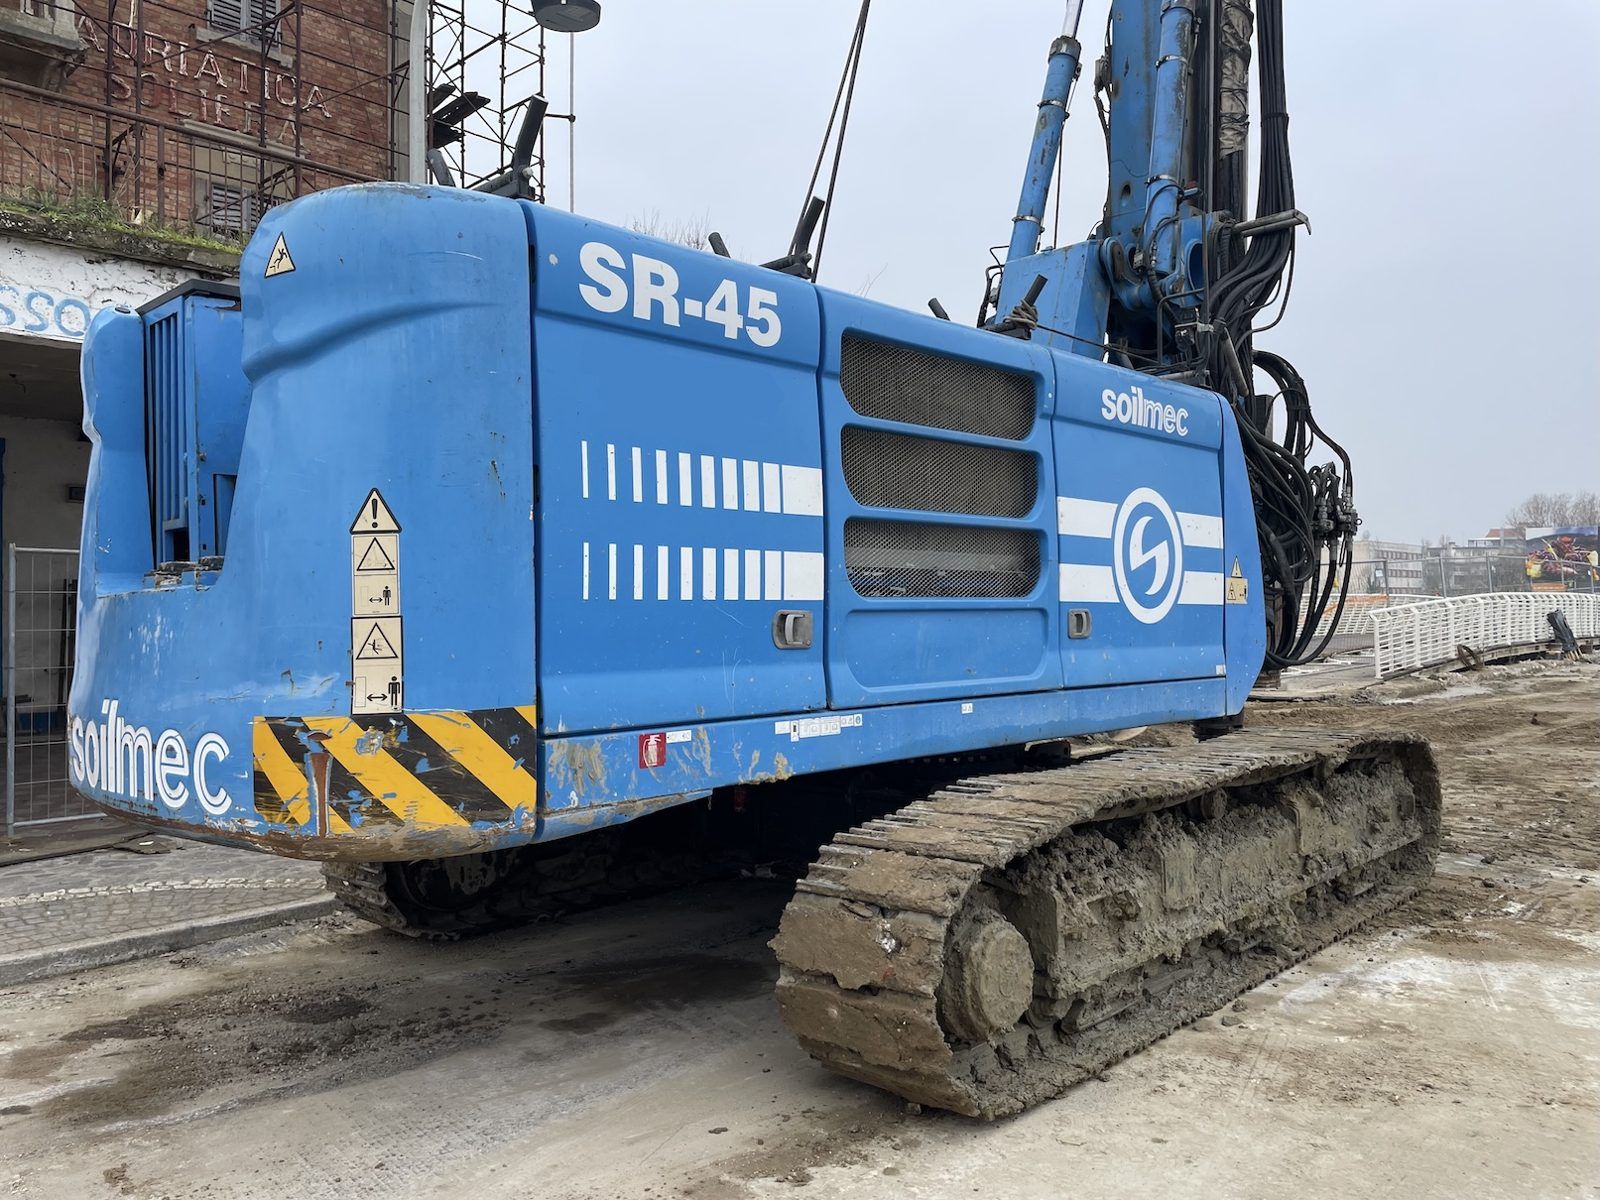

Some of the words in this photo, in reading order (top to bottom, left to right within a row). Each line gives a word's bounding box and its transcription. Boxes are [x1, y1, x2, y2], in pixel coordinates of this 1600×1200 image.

[578, 241, 782, 348] SR-45
[1101, 385, 1189, 437] soilmec
[71, 698, 233, 816] soilmec
